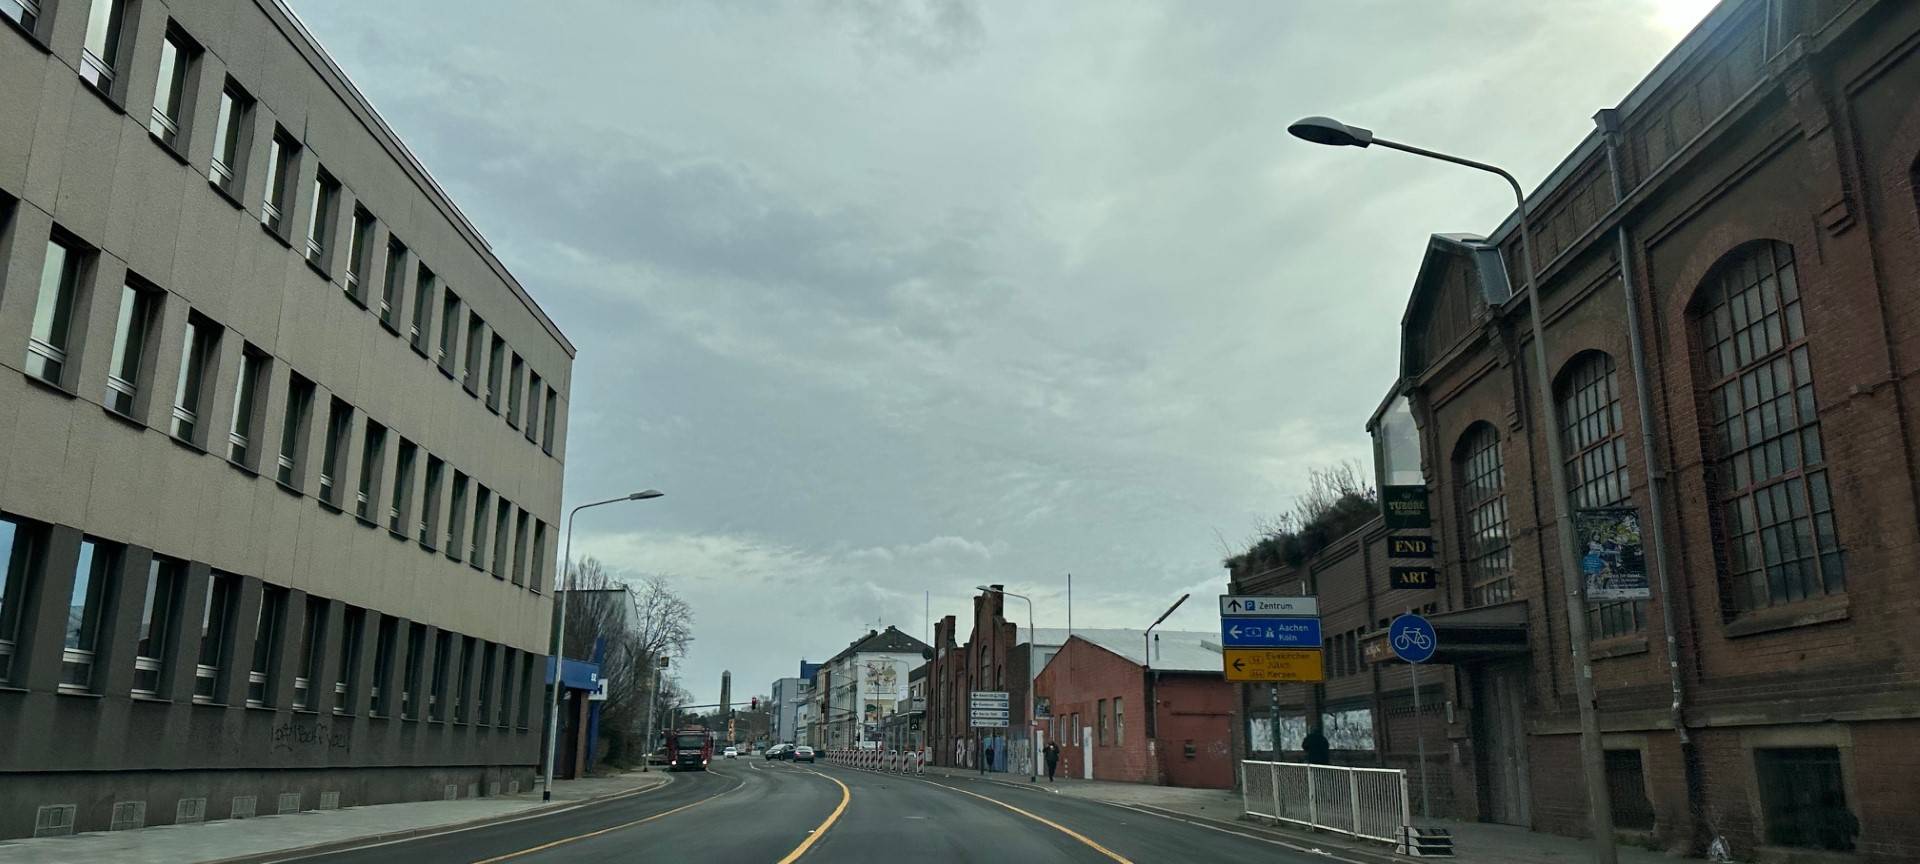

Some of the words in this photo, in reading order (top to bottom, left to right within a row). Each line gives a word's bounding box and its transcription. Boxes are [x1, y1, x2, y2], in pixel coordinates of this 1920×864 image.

[1395, 541, 1426, 553] END
[1400, 571, 1428, 583] ART
[1259, 602, 1293, 610] Zentrum
[1279, 624, 1309, 632] Aachen
[1279, 633, 1298, 641] Köln
